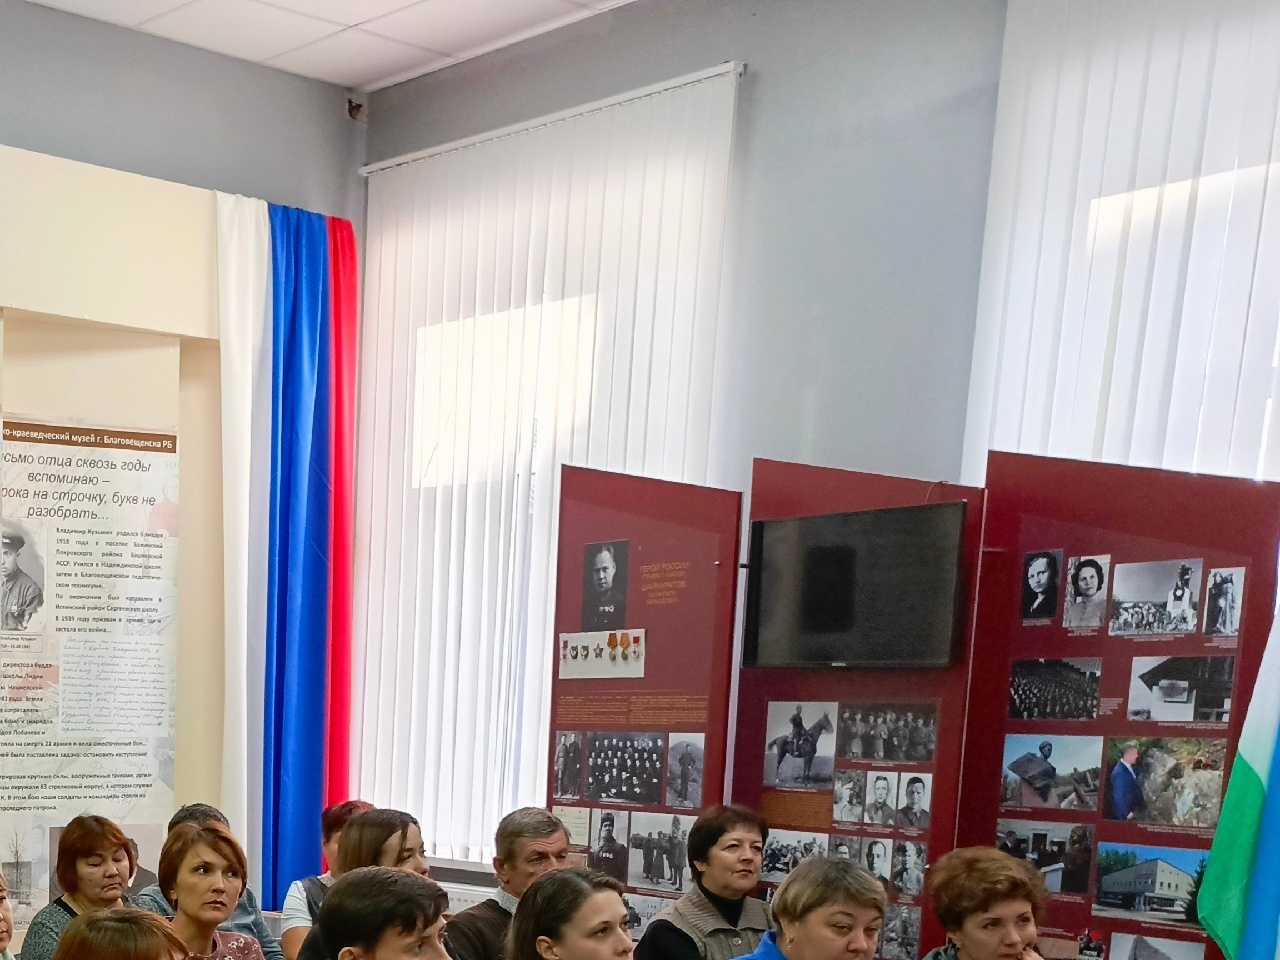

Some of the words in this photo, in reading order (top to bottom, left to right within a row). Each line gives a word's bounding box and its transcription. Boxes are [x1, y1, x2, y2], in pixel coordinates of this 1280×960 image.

[71, 433, 95, 443] музей
[103, 435, 161, 448] Благовещенска
[162, 440, 172, 448] РБ
[37, 455, 72, 468] отца
[75, 458, 117, 469] сквозь
[120, 458, 151, 472] годы
[27, 472, 98, 486] вспоминаю
[32, 489, 48, 500] на
[51, 488, 107, 506] строчку,
[111, 491, 138, 507] букв
[141, 496, 156, 506] не
[26, 505, 108, 521] разобрать...
